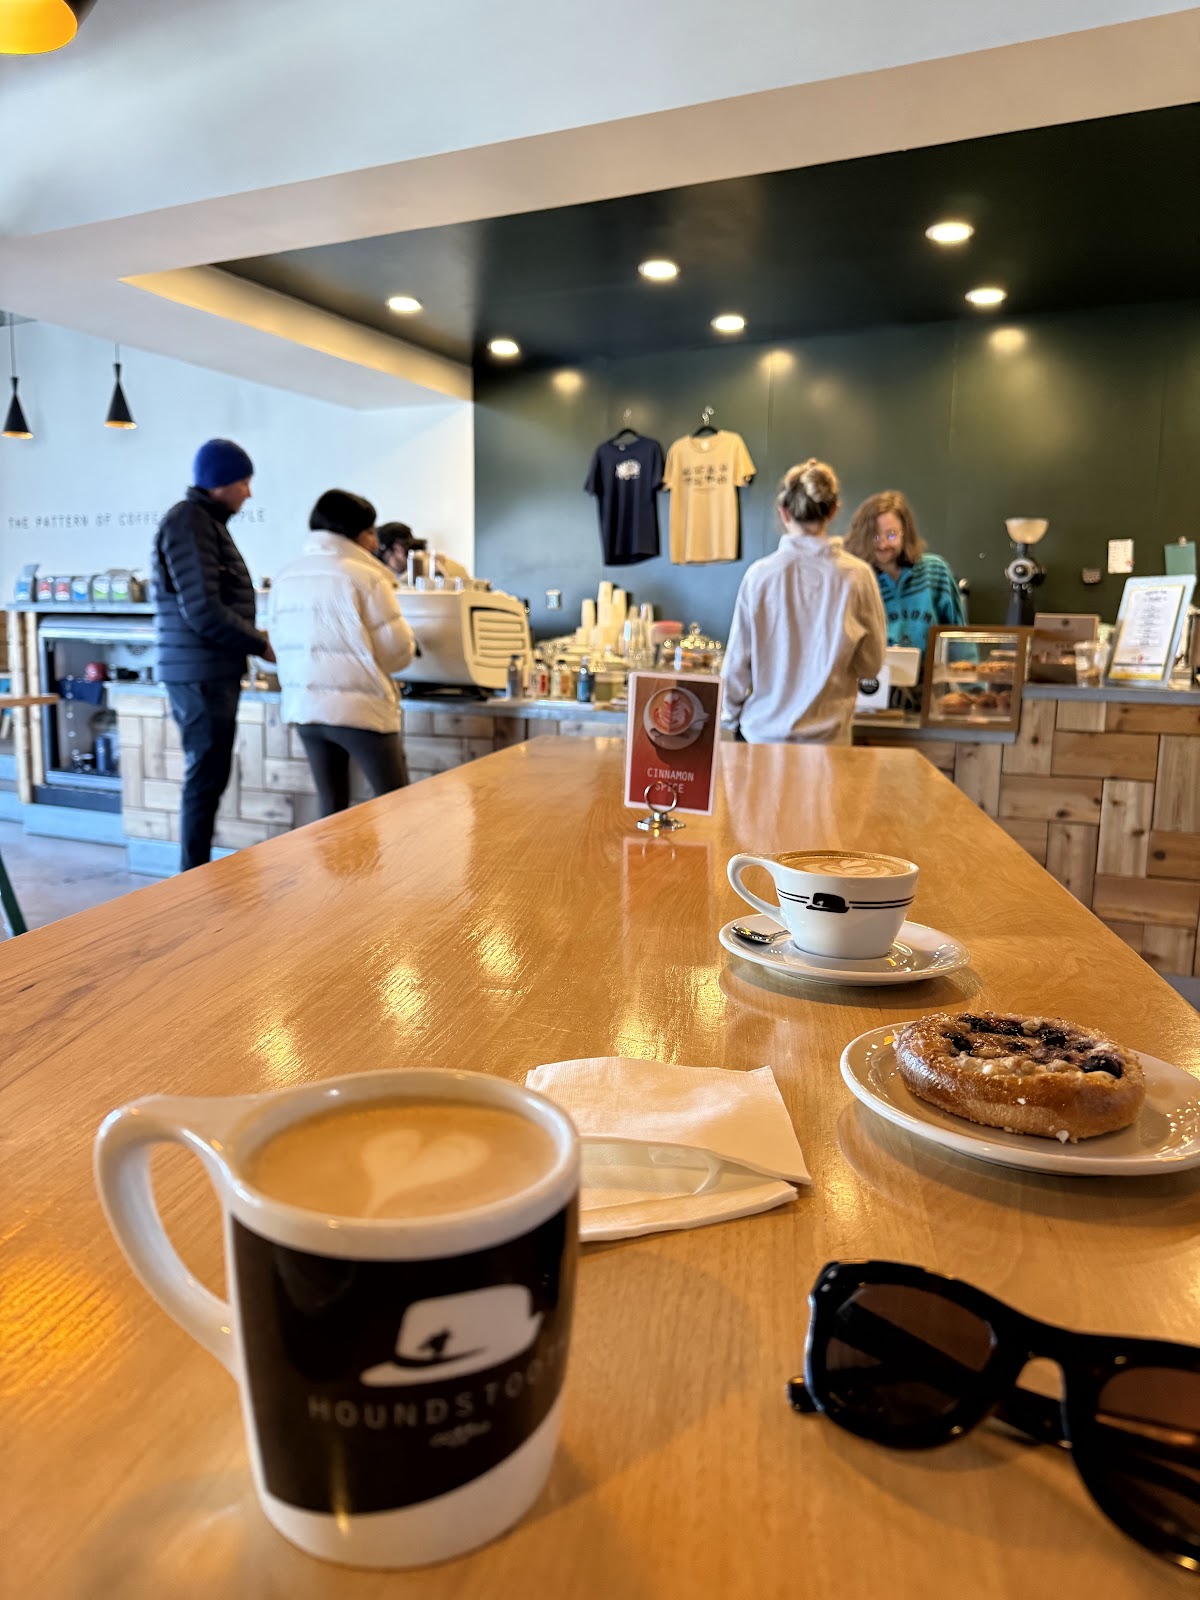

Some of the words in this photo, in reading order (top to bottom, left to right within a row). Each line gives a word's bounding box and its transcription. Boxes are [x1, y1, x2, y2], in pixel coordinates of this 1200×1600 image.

[8, 516, 30, 530] THE
[35, 514, 88, 528] PATTERN
[96, 512, 111, 527] OF
[118, 511, 165, 526] COFFE
[646, 767, 694, 782] CINNAMON
[307, 1346, 557, 1430] HOUNDSTOO
